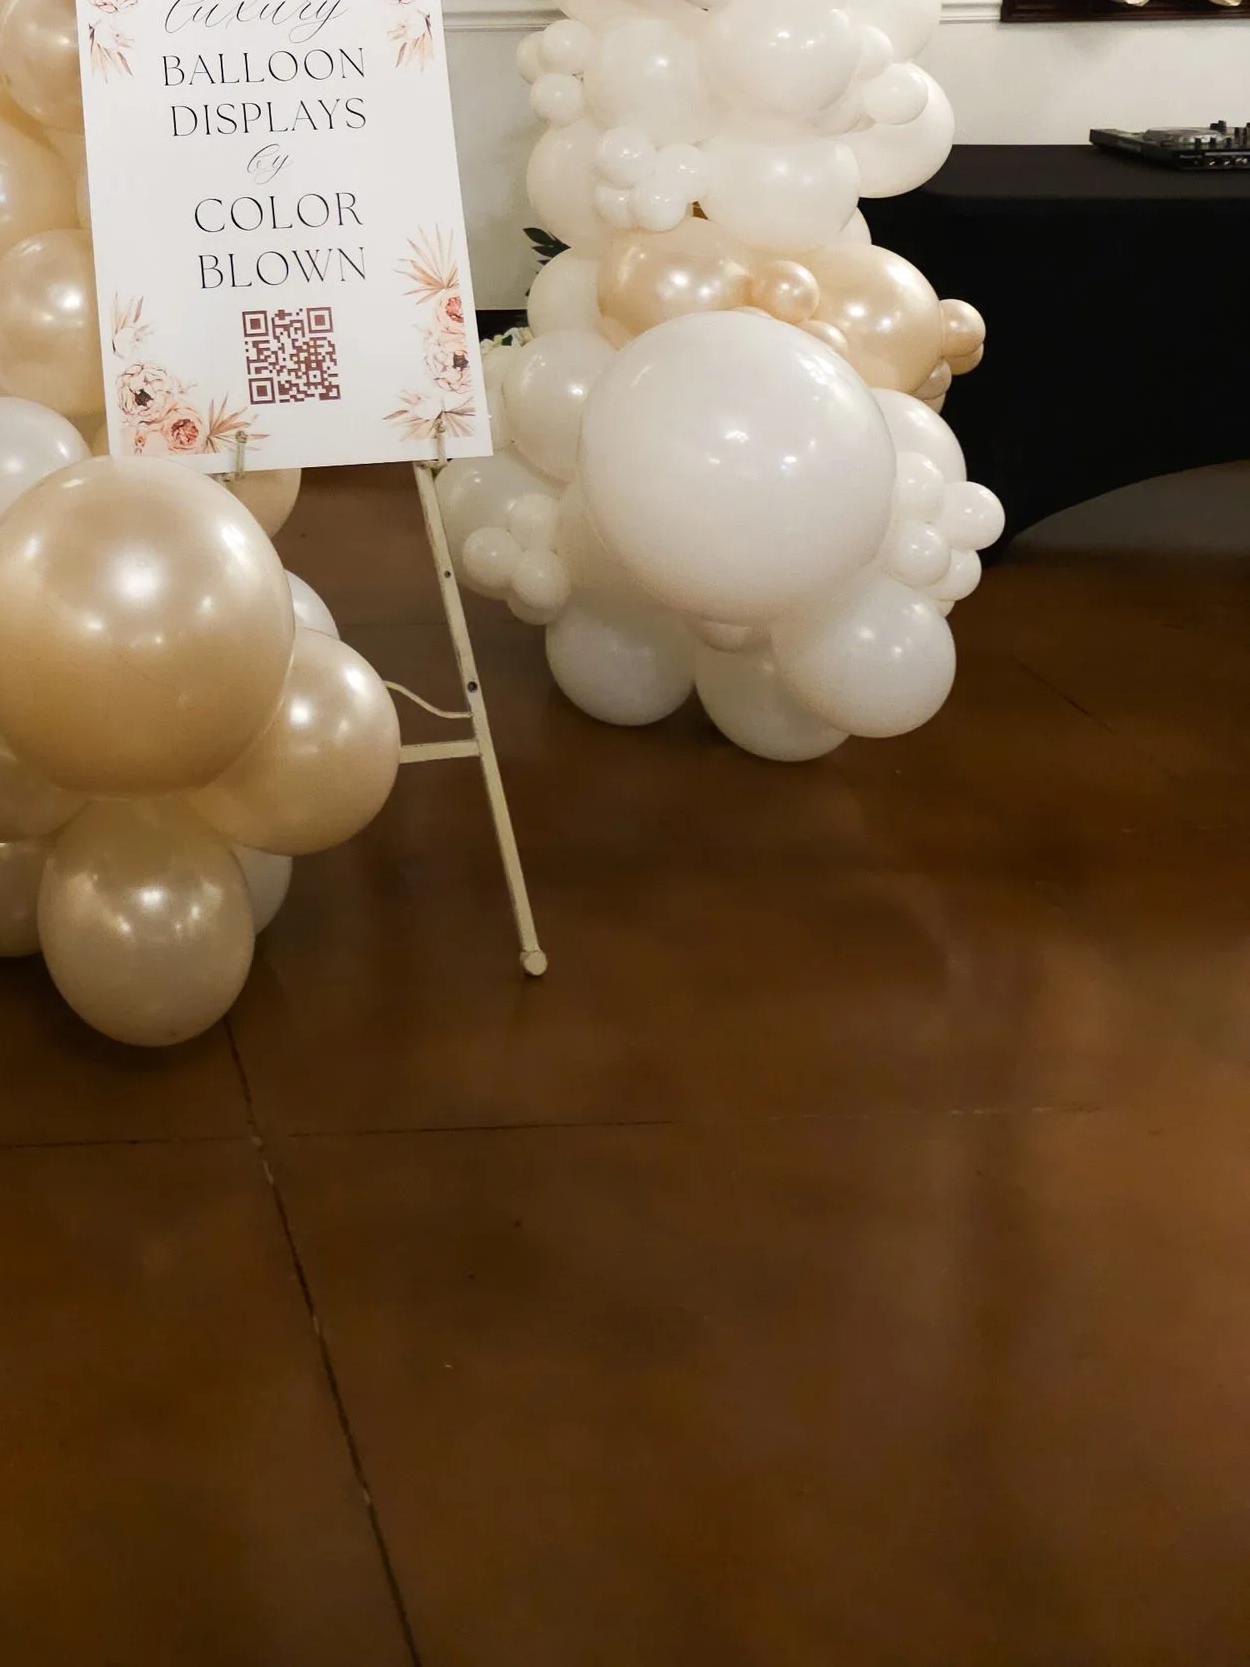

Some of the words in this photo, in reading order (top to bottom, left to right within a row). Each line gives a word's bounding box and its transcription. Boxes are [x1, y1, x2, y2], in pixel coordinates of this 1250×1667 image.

[162, 47, 366, 86] BALLOON
[171, 97, 367, 137] DISPLAYS
[246, 143, 292, 184] by
[194, 192, 364, 233] COLOR
[198, 246, 367, 289] BLOWN
